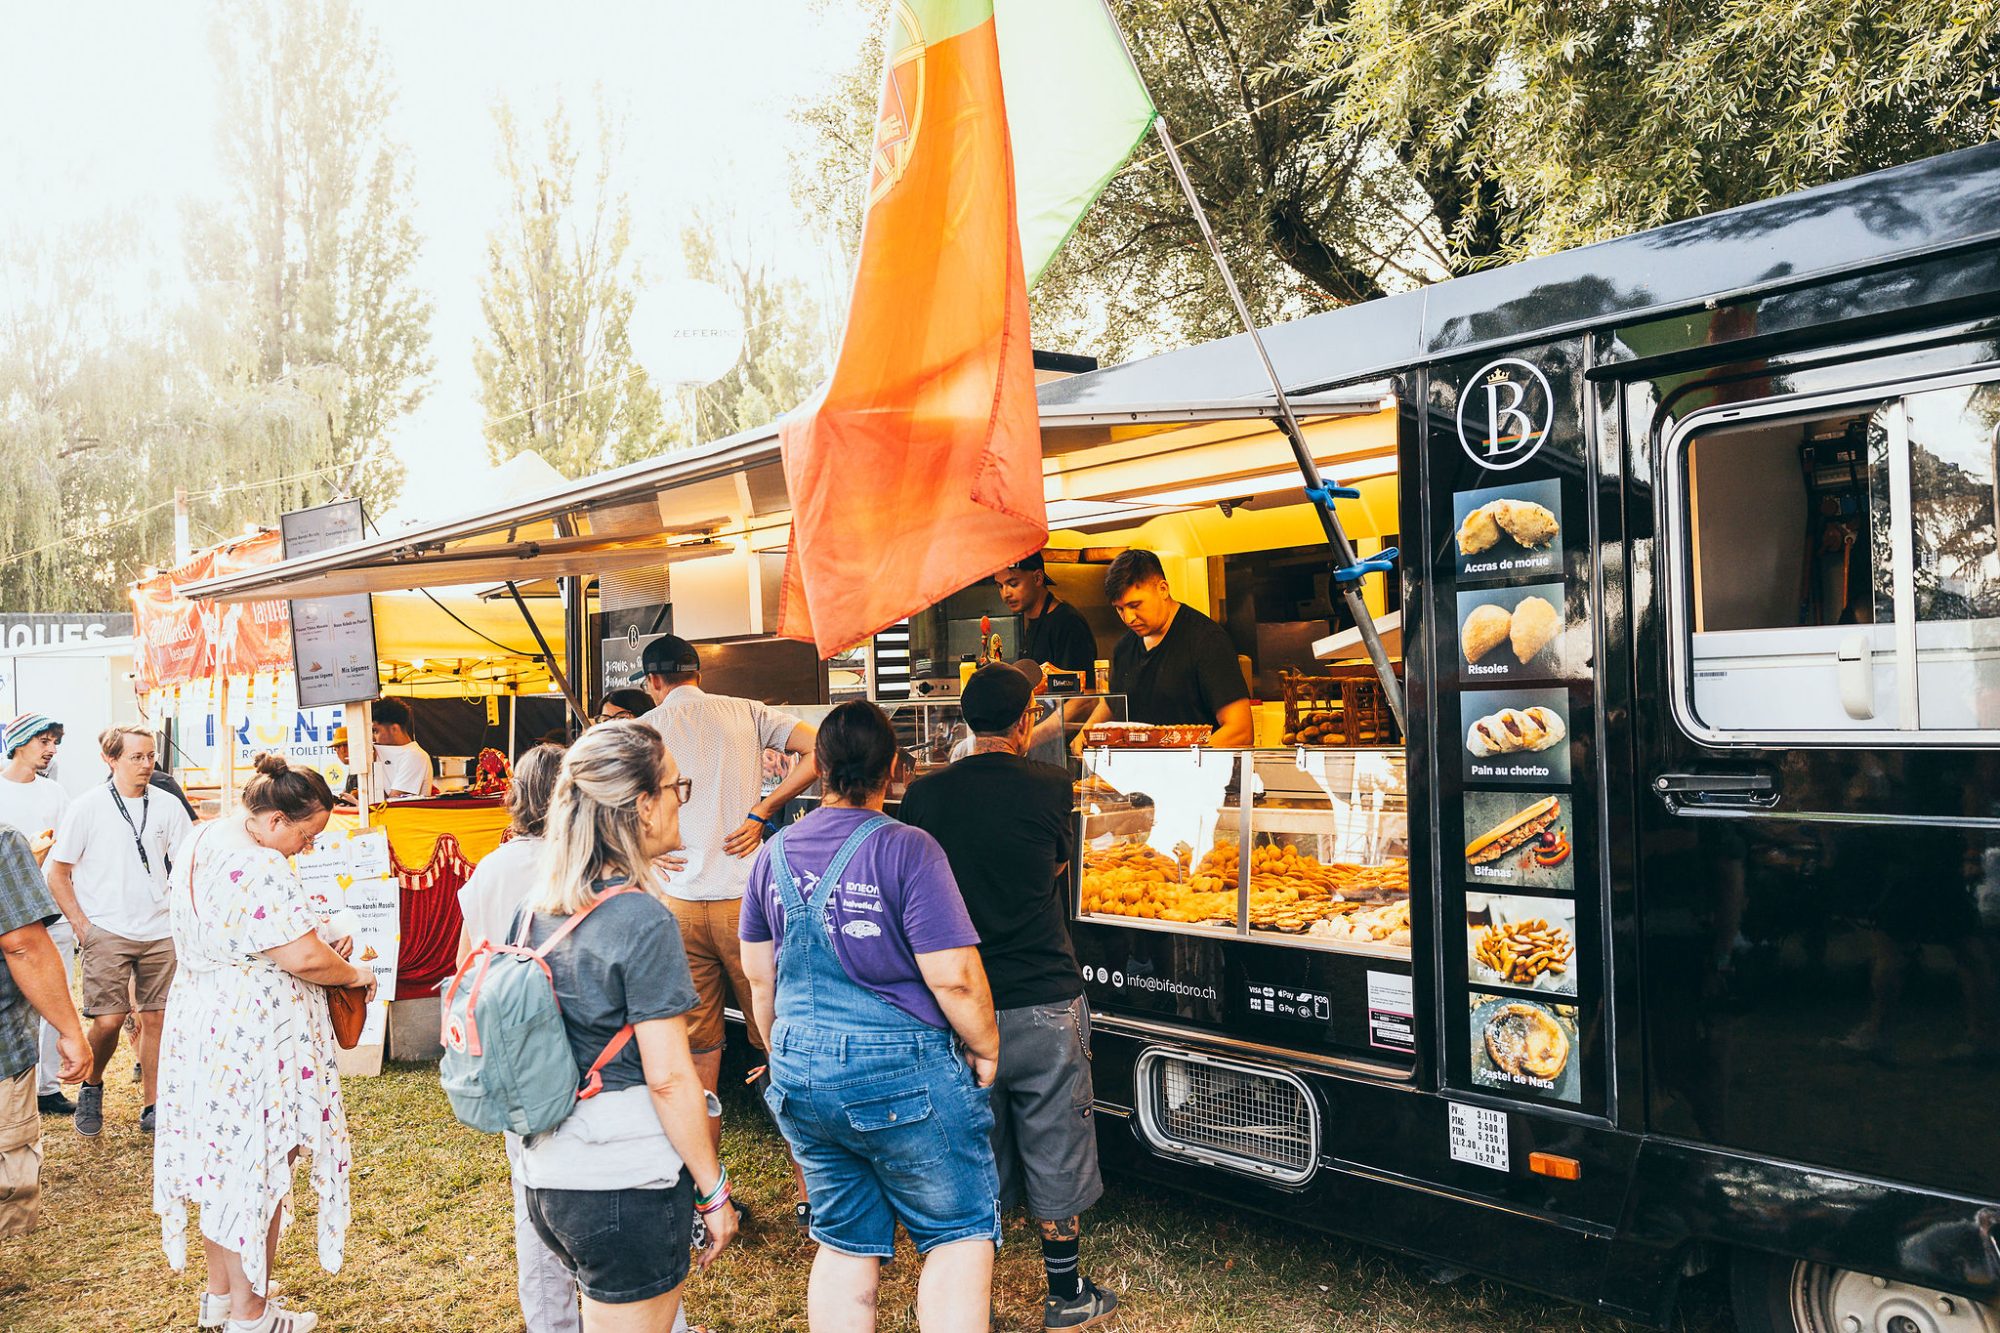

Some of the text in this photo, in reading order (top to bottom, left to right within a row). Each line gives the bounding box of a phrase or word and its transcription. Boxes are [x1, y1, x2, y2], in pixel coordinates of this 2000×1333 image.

[1480, 381, 1532, 457] B
[1464, 556, 1549, 573] Accras de morue
[1468, 664, 1509, 674] Rissoles
[1471, 765, 1549, 776] Pain au chorizo
[1474, 865, 1512, 878] Bifanas
[1477, 966, 1506, 980] Frites
[1127, 973, 1217, 1000] info@bifadoro.ch
[1248, 986, 1262, 994] VISA
[1285, 1005, 1295, 1014] Pay
[1480, 1067, 1554, 1090] Pastel de Nata
[1478, 1121, 1498, 1133] 3.500
[1478, 1131, 1498, 1144] 5.250
[1475, 1151, 1495, 1164] 15.20
